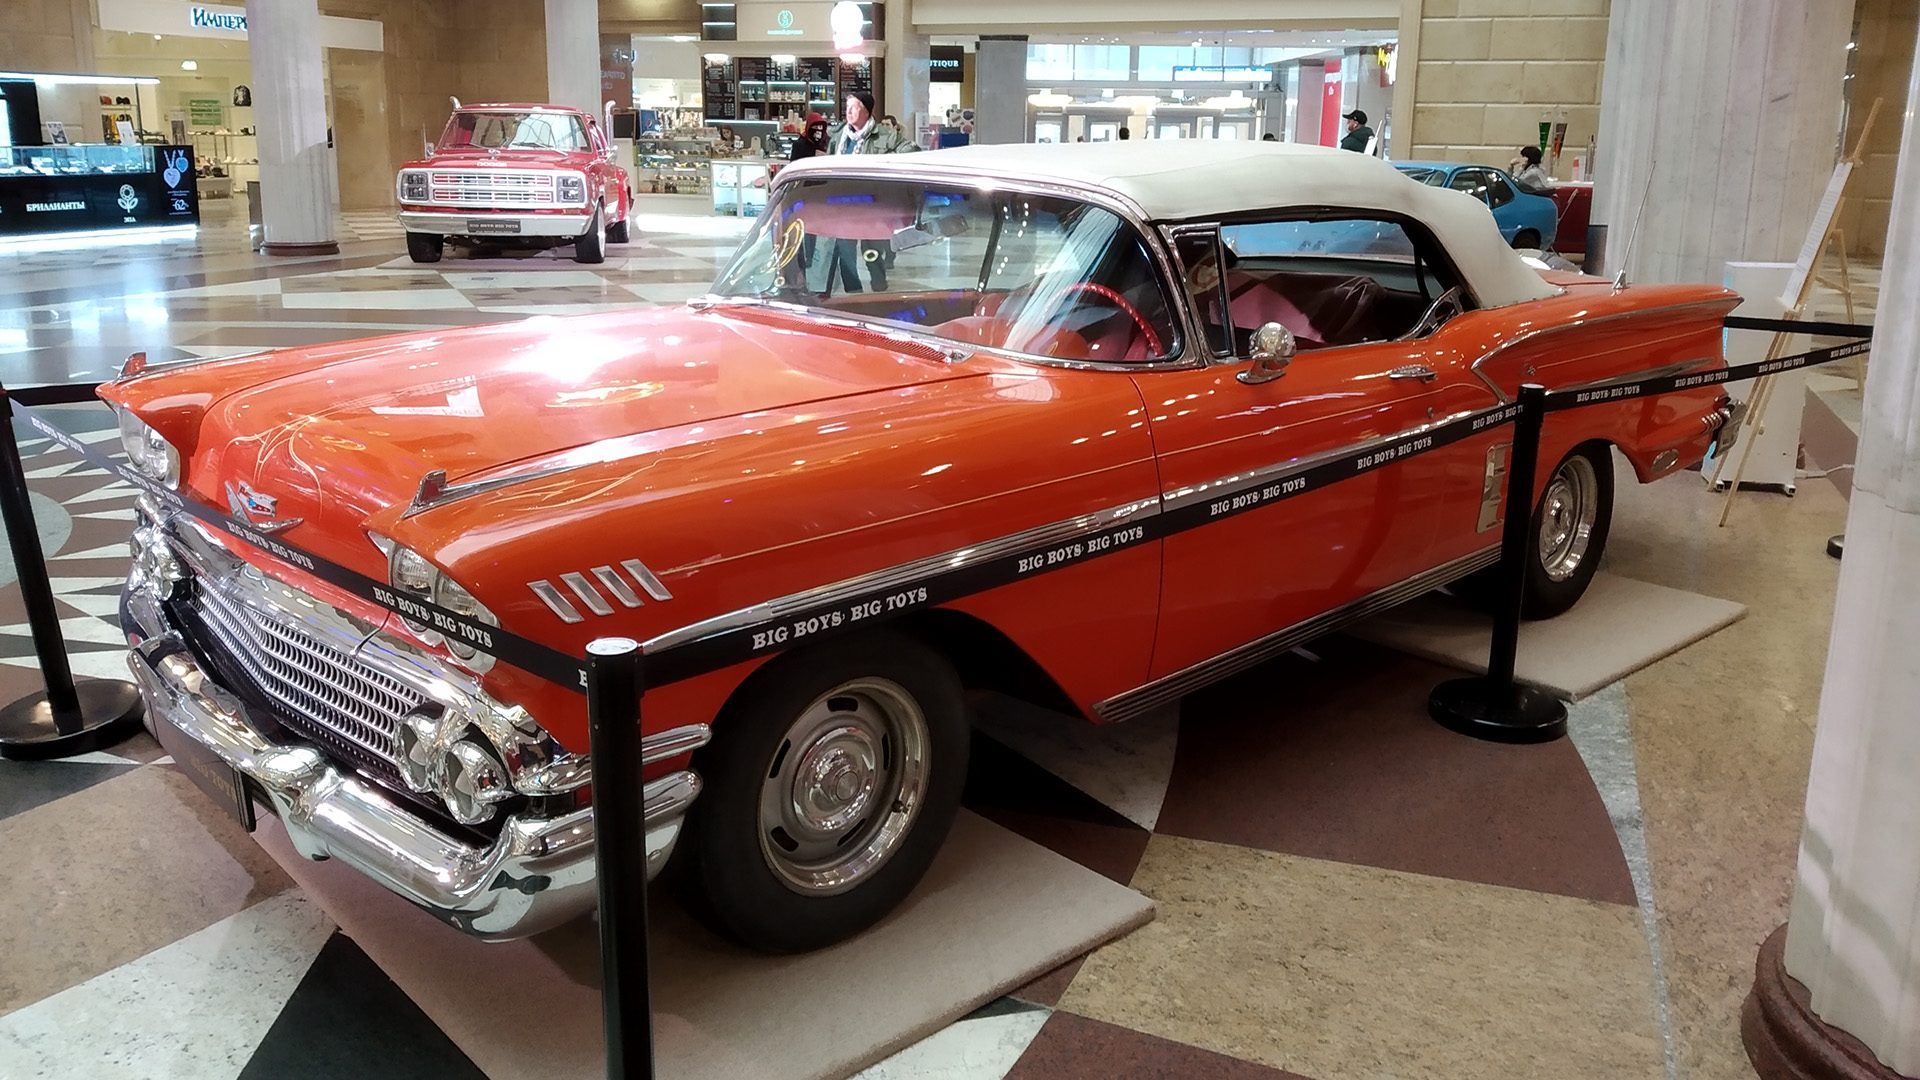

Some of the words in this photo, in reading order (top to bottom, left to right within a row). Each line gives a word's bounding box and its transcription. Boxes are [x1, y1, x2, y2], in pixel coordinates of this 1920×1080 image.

[26, 201, 85, 211] БРИЛЛИАНТЫ
[1675, 378, 1686, 387] BIG
[1704, 374, 1714, 382] BIG
[1715, 371, 1728, 380] TOYS
[1759, 364, 1768, 372] BIG
[1783, 360, 1792, 368] BIG
[1577, 393, 1589, 402] BIG
[1611, 388, 1622, 397] BIG
[1624, 385, 1640, 395] TOYS
[1473, 418, 1485, 429] BIG
[1505, 407, 1516, 418] BIG
[1357, 456, 1372, 470] BIG
[1398, 443, 1411, 456] BIG
[1413, 436, 1432, 450] TOYS
[1210, 500, 1230, 515] BIG
[1263, 485, 1280, 500] BIG
[1282, 477, 1305, 493] TOYS
[225, 521, 244, 537] BIG
[268, 541, 288, 558] BIG
[287, 549, 314, 570] TOYS
[1018, 554, 1044, 573] BIG
[1088, 536, 1110, 553] BIG
[1114, 526, 1143, 545] TOYS
[372, 586, 395, 606] BIG
[432, 611, 456, 633] BIG
[458, 621, 492, 648] TOYS
[752, 627, 789, 650] BIG
[851, 600, 882, 621] BIG
[886, 587, 927, 612] TOYS
